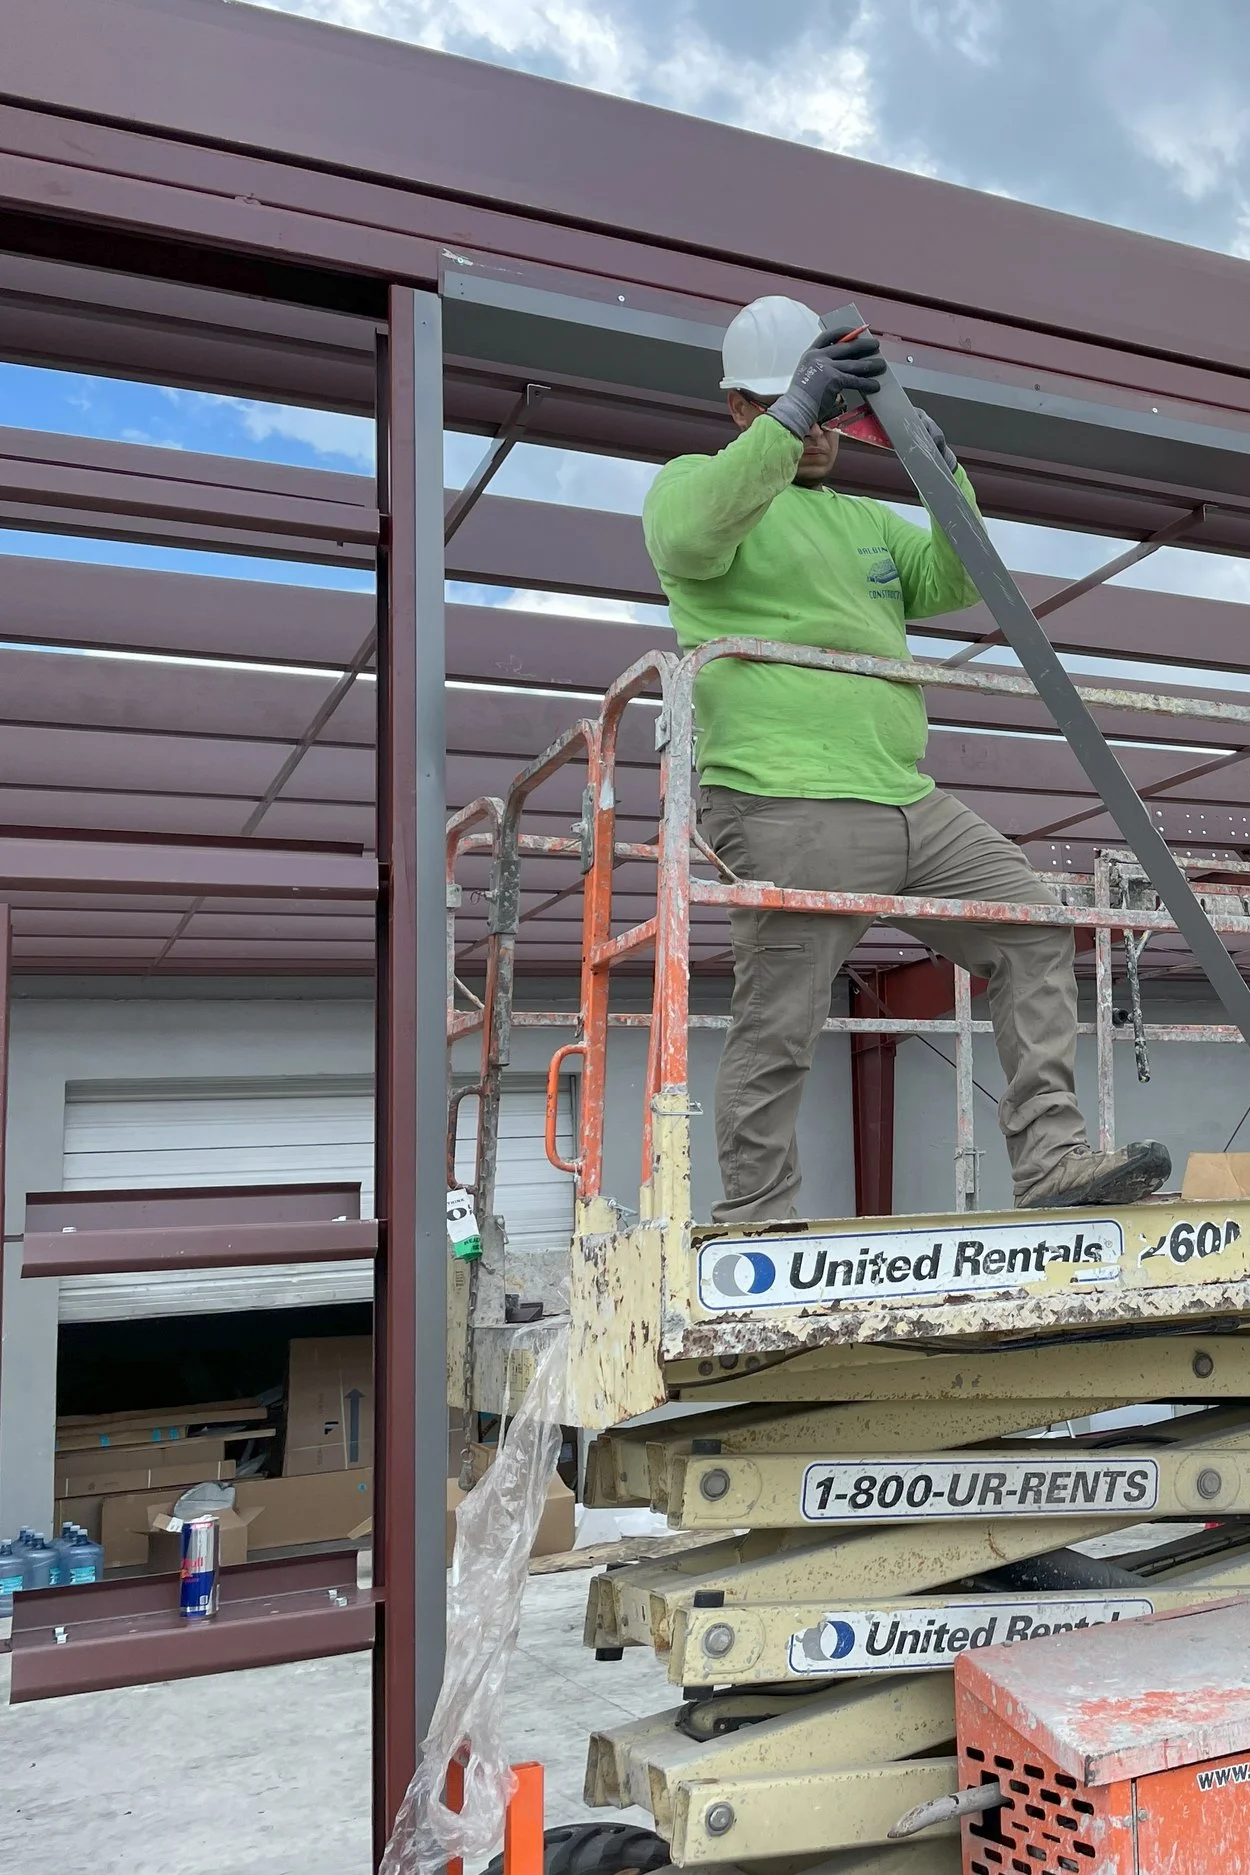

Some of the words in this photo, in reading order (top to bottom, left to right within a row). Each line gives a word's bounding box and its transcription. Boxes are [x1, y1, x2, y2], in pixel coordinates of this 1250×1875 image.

[789, 1243, 943, 1290] United
[952, 1233, 1103, 1278] Rentals
[814, 1469, 1149, 1510] 1-800-UR-RENTS
[865, 1616, 998, 1656] United
